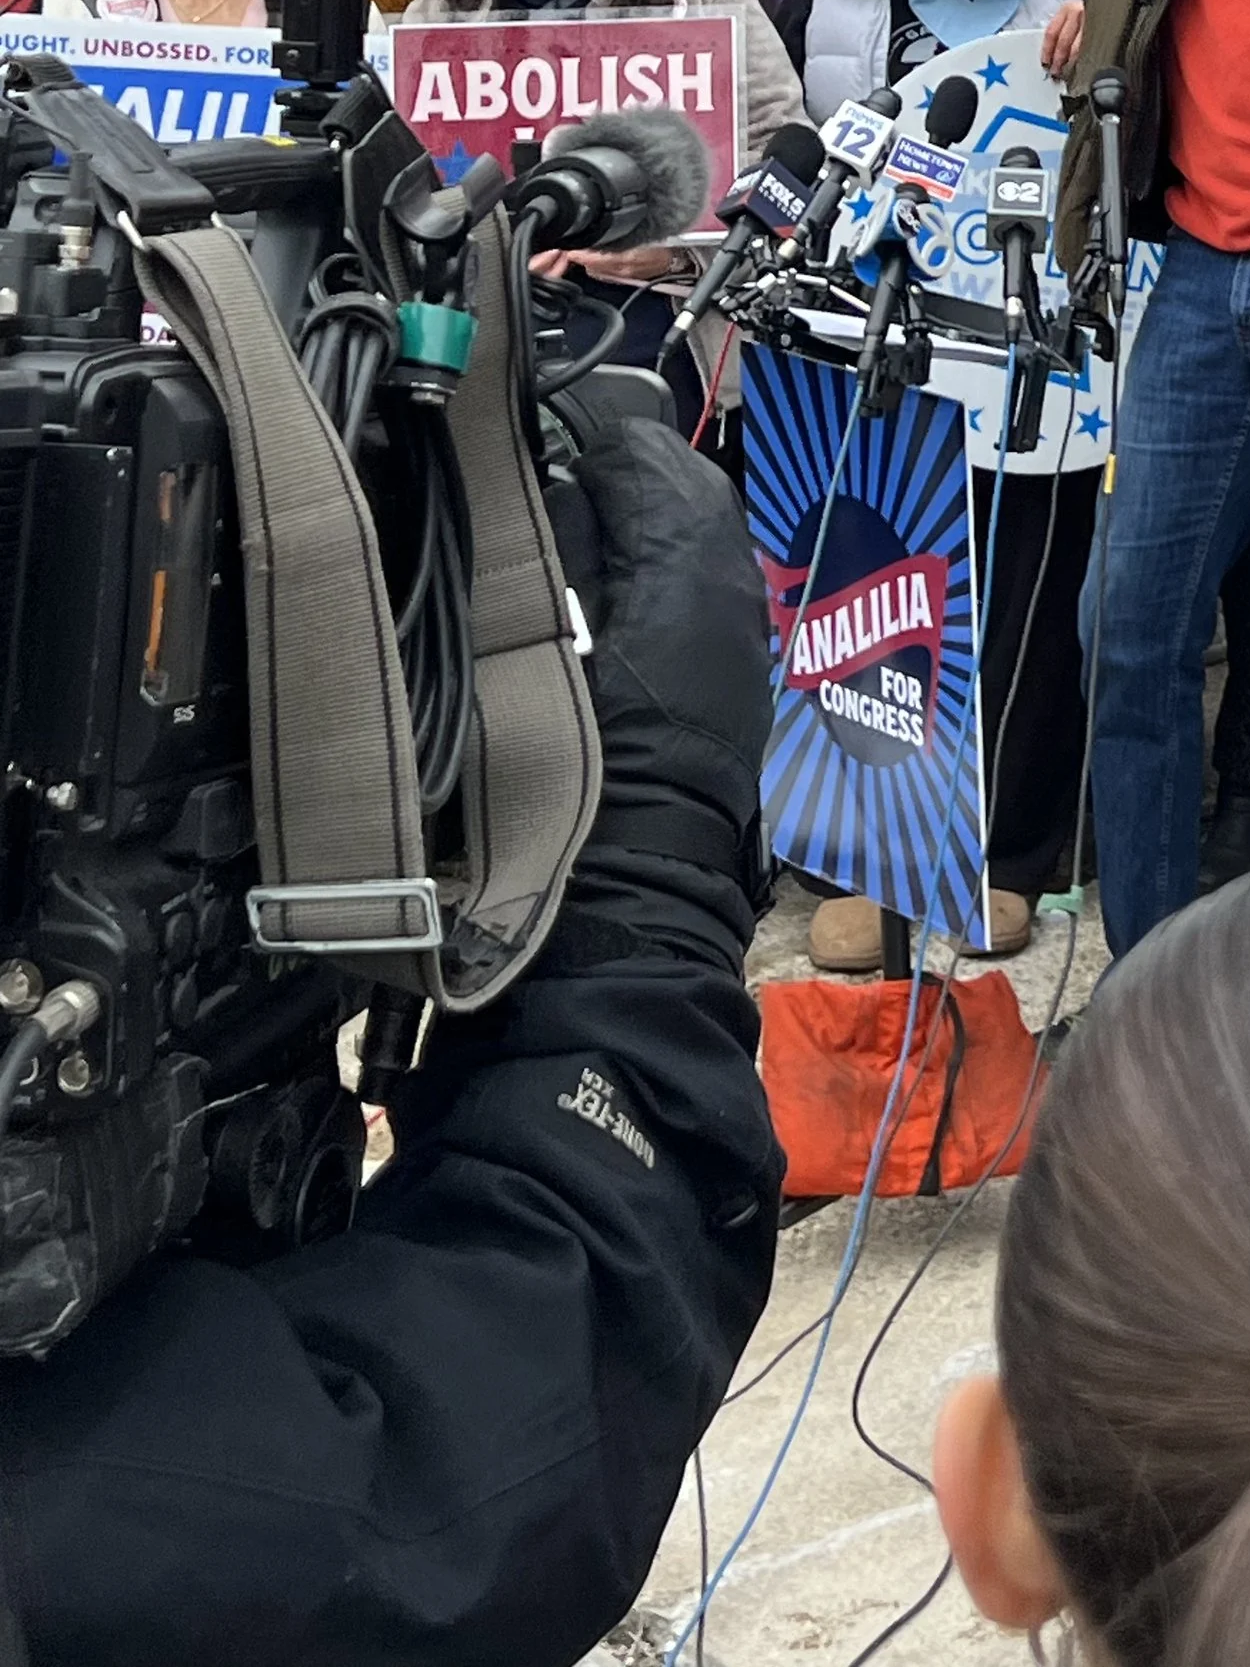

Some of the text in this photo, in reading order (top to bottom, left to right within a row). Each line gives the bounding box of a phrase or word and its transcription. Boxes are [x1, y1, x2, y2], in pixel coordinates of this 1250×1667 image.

[0, 33, 270, 65] UGHT. UNBOSSED. FOR
[410, 52, 716, 123] ABOLISH
[831, 120, 876, 160] 12
[793, 572, 933, 675] ANALILIA
[820, 679, 924, 747] CONGRESS
[881, 666, 923, 712] FOR
